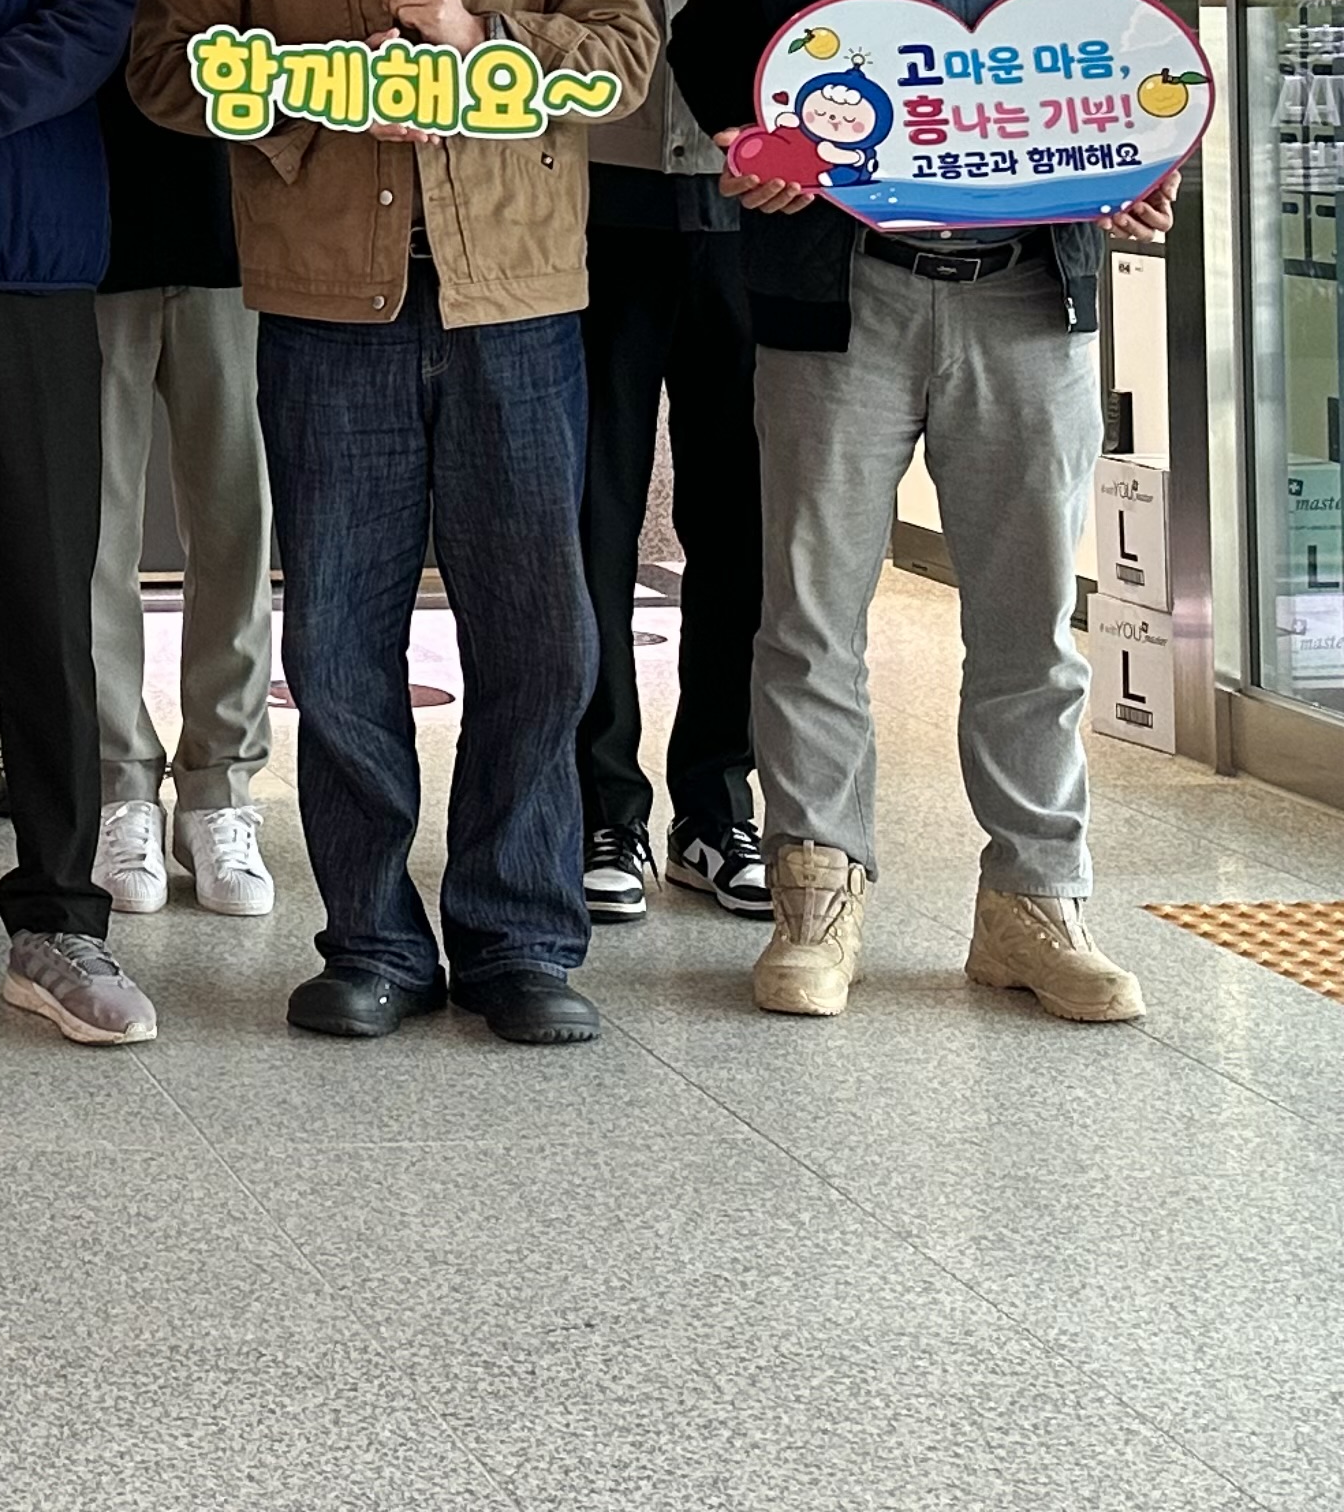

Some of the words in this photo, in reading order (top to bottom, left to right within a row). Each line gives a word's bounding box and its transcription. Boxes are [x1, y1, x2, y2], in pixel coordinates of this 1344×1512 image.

[197, 30, 613, 135] 함께해요~
[897, 44, 1024, 88] 고마운
[1033, 39, 1131, 81] 마음,
[903, 94, 1029, 145] 흥나는
[1040, 93, 1135, 135] 기부!
[911, 149, 1018, 181] 고흥군과
[1027, 141, 1143, 176] 함께해요
[1118, 510, 1138, 562] L
[1307, 545, 1340, 588] L
[1122, 650, 1146, 703] L
